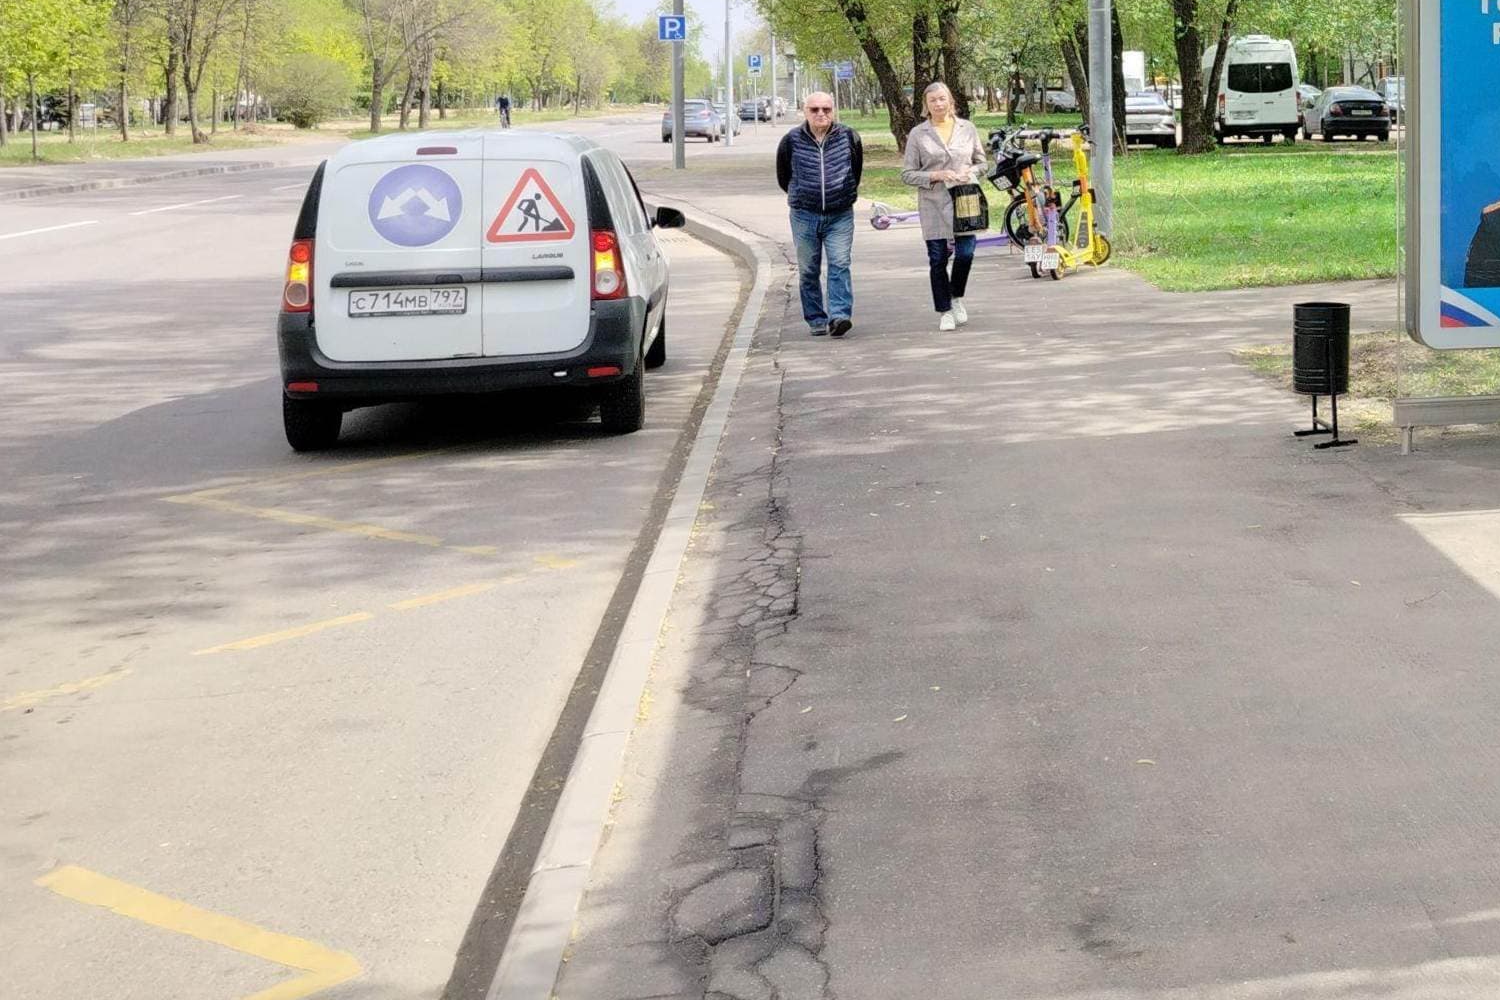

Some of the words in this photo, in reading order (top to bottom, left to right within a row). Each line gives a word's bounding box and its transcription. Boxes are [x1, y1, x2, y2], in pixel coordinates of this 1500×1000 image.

[665, 19, 680, 38] P
[355, 293, 427, 310] С714МВ
[432, 290, 461, 304] 797
